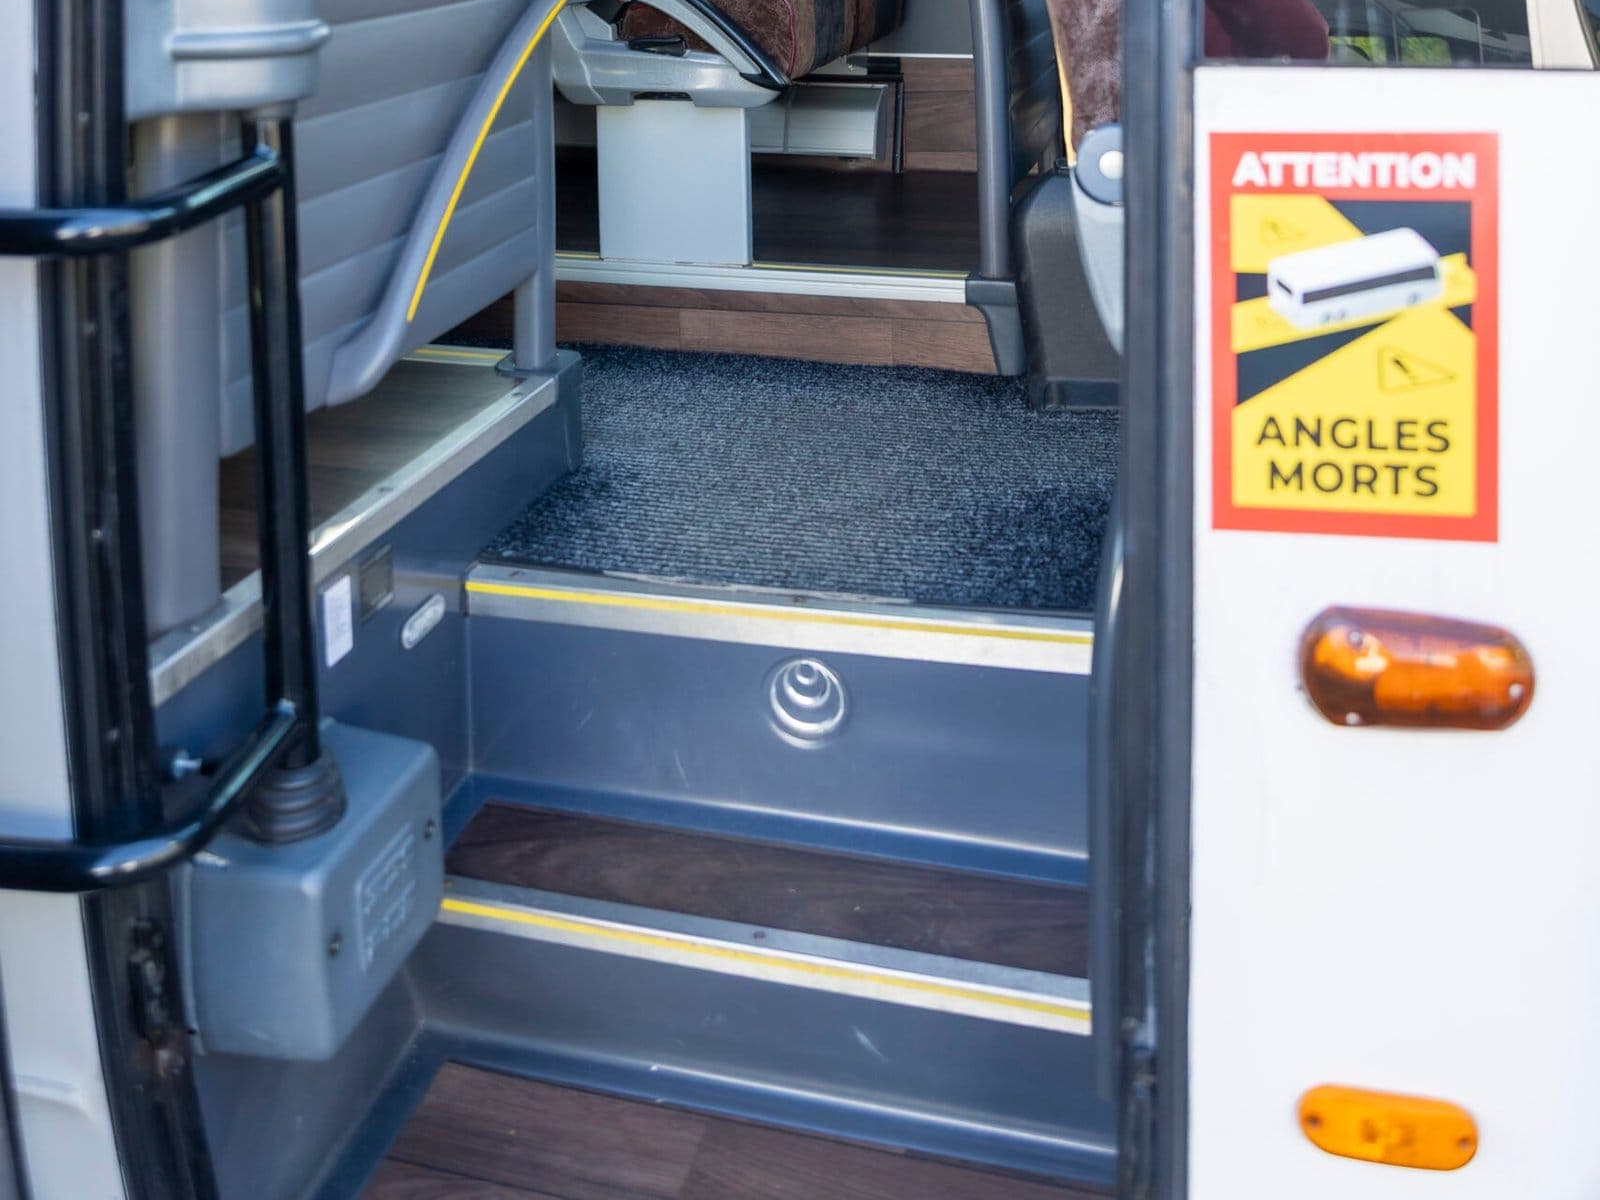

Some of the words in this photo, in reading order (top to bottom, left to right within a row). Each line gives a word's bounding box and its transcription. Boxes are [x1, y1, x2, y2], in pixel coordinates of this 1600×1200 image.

[1231, 151, 1477, 189] ATTENTION
[1257, 416, 1450, 453] ANGLES
[1269, 461, 1439, 497] MORTS
